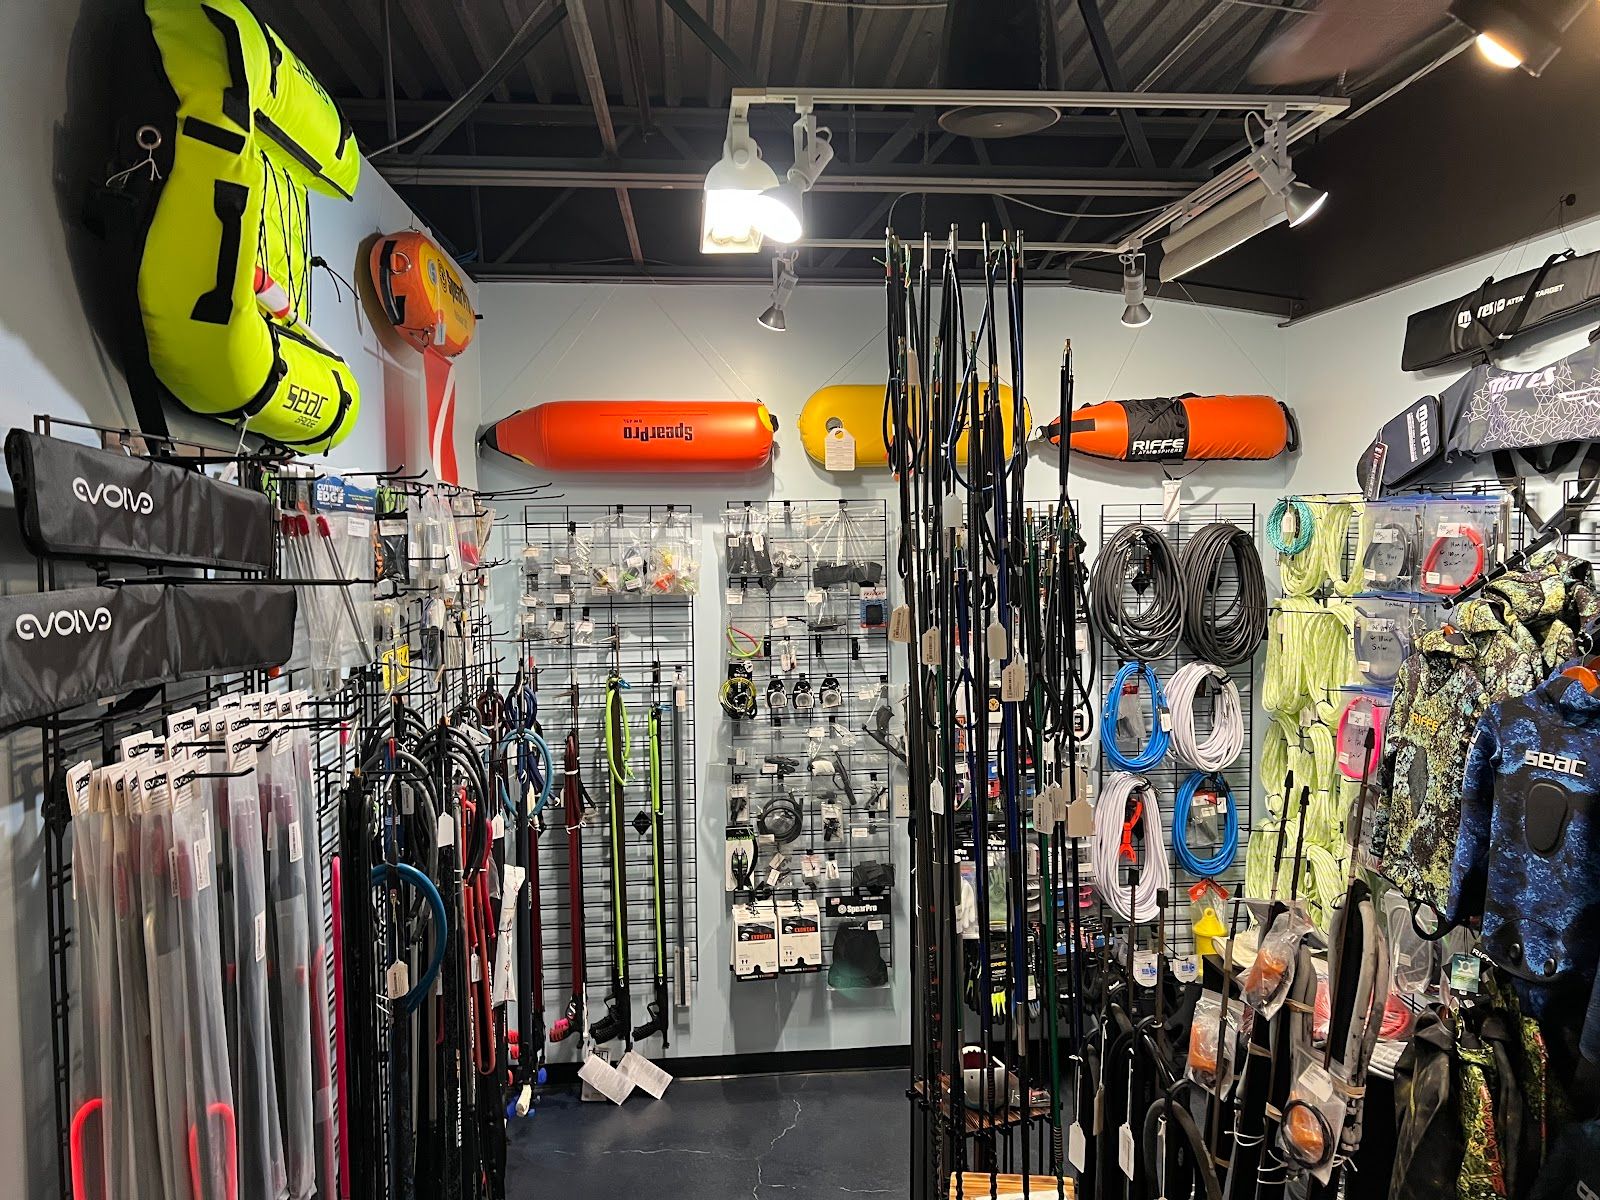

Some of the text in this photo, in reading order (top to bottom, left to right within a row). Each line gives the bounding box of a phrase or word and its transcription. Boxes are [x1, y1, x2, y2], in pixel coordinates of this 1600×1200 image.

[1458, 301, 1495, 328] mres
[1535, 284, 1565, 298] TARGET
[623, 422, 693, 442] SpearPro
[1415, 403, 1431, 456] mares
[1132, 438, 1185, 451] RIFFE
[316, 490, 344, 504] EDGE
[1411, 712, 1440, 732] RIFFE
[846, 904, 878, 914] SpearPro
